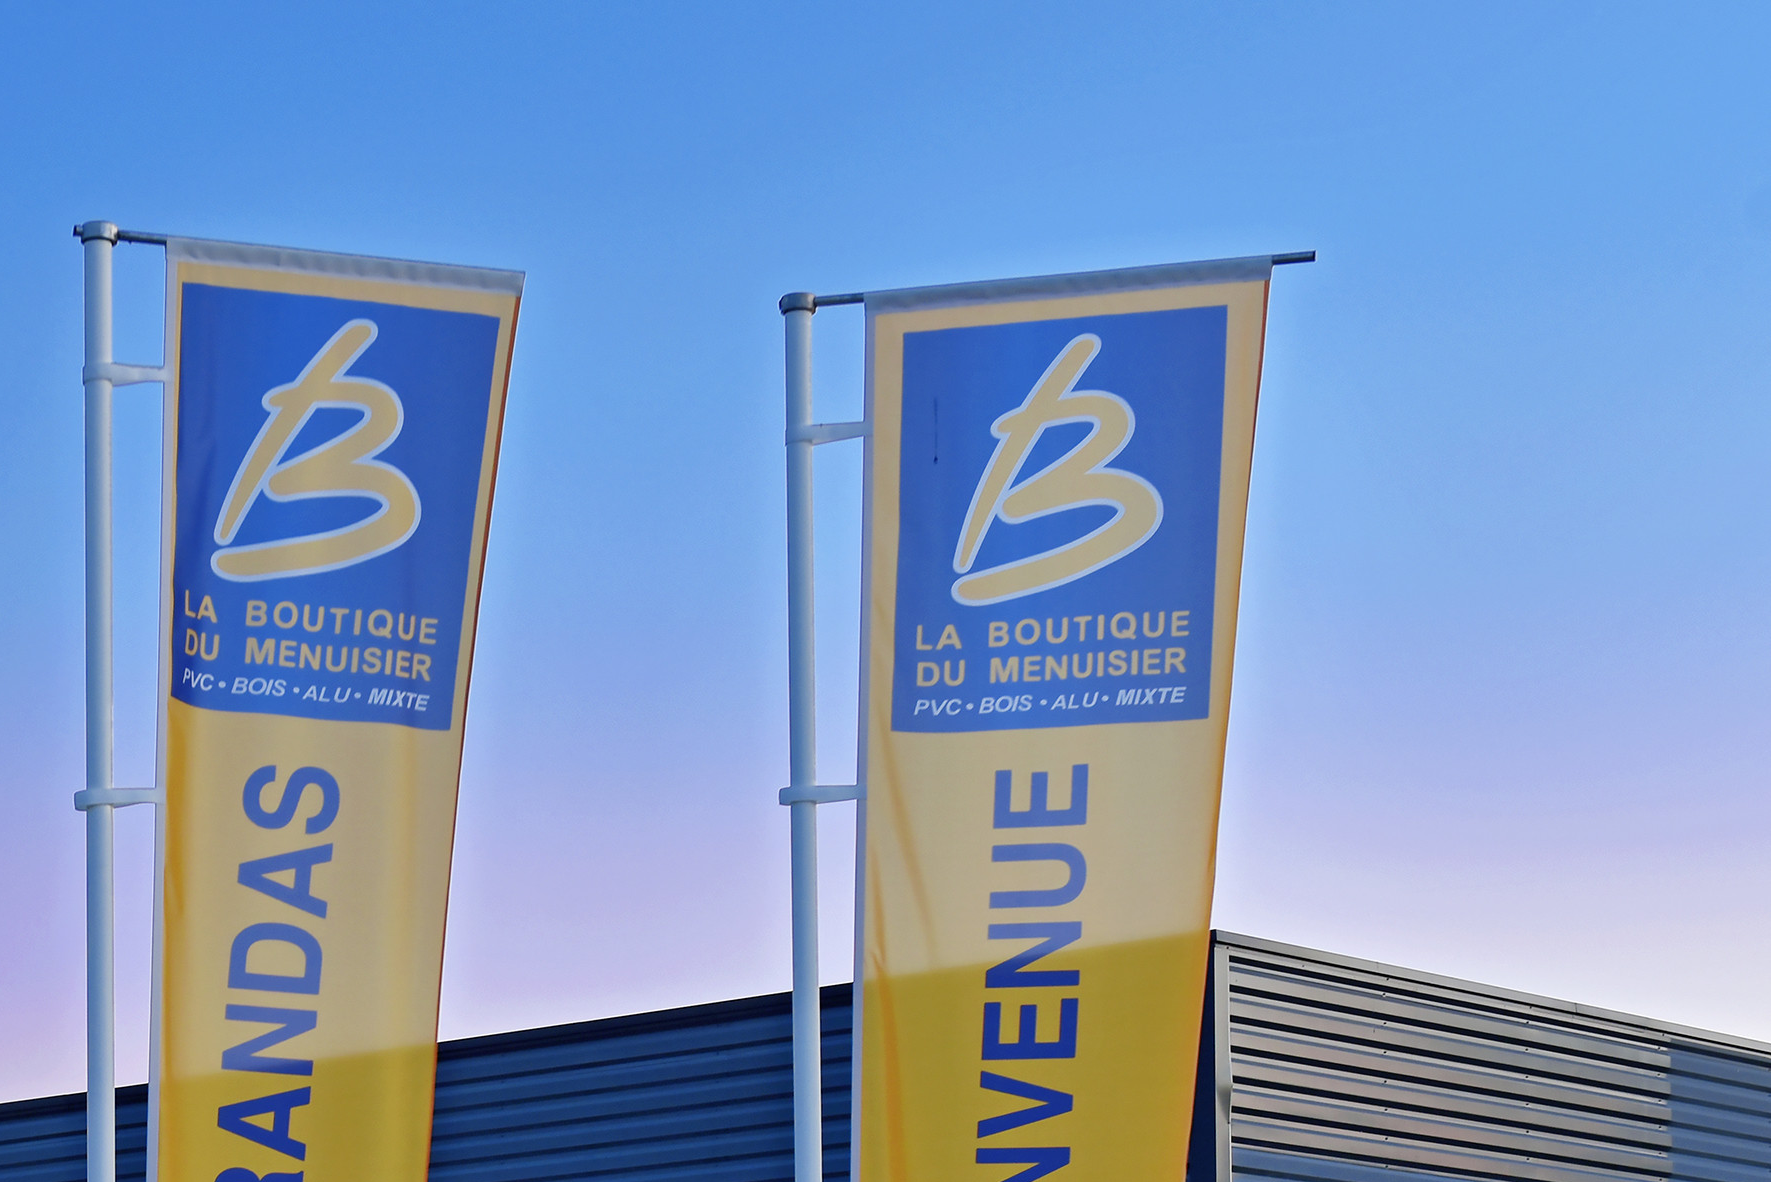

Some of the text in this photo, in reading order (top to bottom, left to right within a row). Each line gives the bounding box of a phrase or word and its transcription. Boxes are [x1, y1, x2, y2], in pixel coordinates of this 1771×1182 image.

[184, 589, 439, 645] LA BOUTIQUE
[915, 610, 1190, 652] LA BOUTIQUE
[185, 628, 432, 681] DU MENUISIER
[916, 646, 1187, 687] DU MENUISIER
[182, 668, 430, 712] PVC BOIS ALU MIXTE
[913, 686, 1187, 716] PVC BOIS ALU MIXTE
